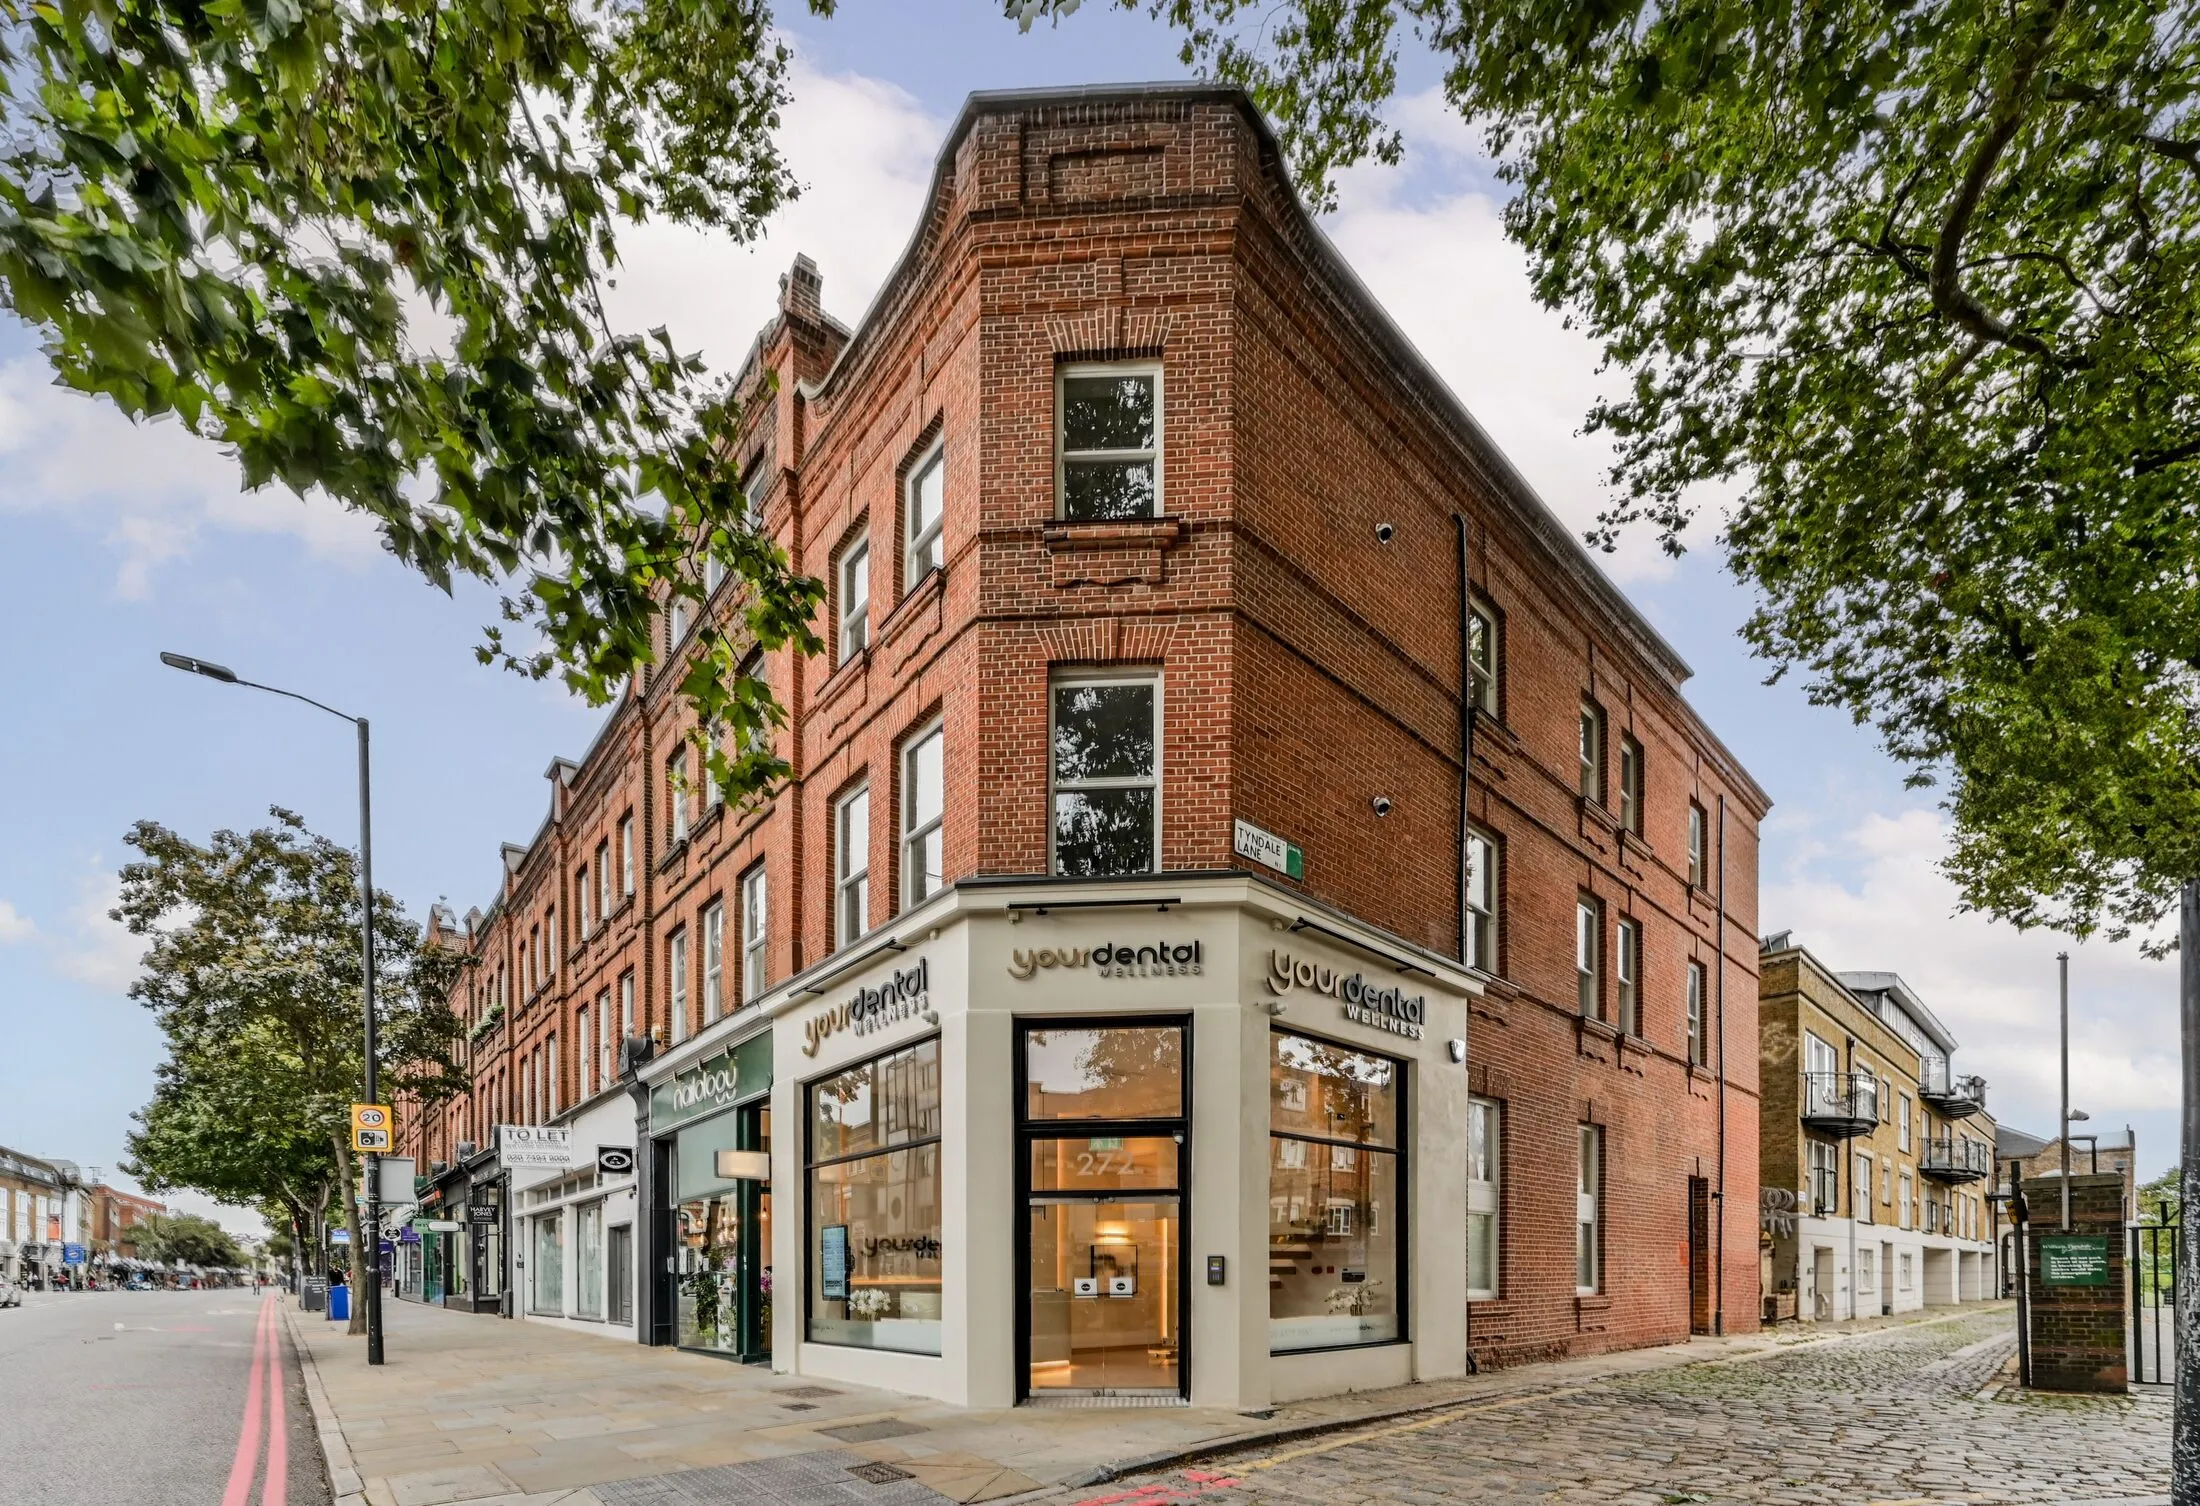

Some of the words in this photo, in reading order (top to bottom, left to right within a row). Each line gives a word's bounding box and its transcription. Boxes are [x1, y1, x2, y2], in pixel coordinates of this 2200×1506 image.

[1237, 839, 1262, 861] LANE
[1238, 827, 1281, 857] TYNDALE
[1098, 964, 1203, 978] WELLNESS
[1344, 1002, 1426, 1041] WELLNESS
[362, 1113, 381, 1122] 20
[504, 1128, 530, 1141] TO
[536, 1129, 569, 1142] LET
[1076, 1152, 1135, 1176] 272
